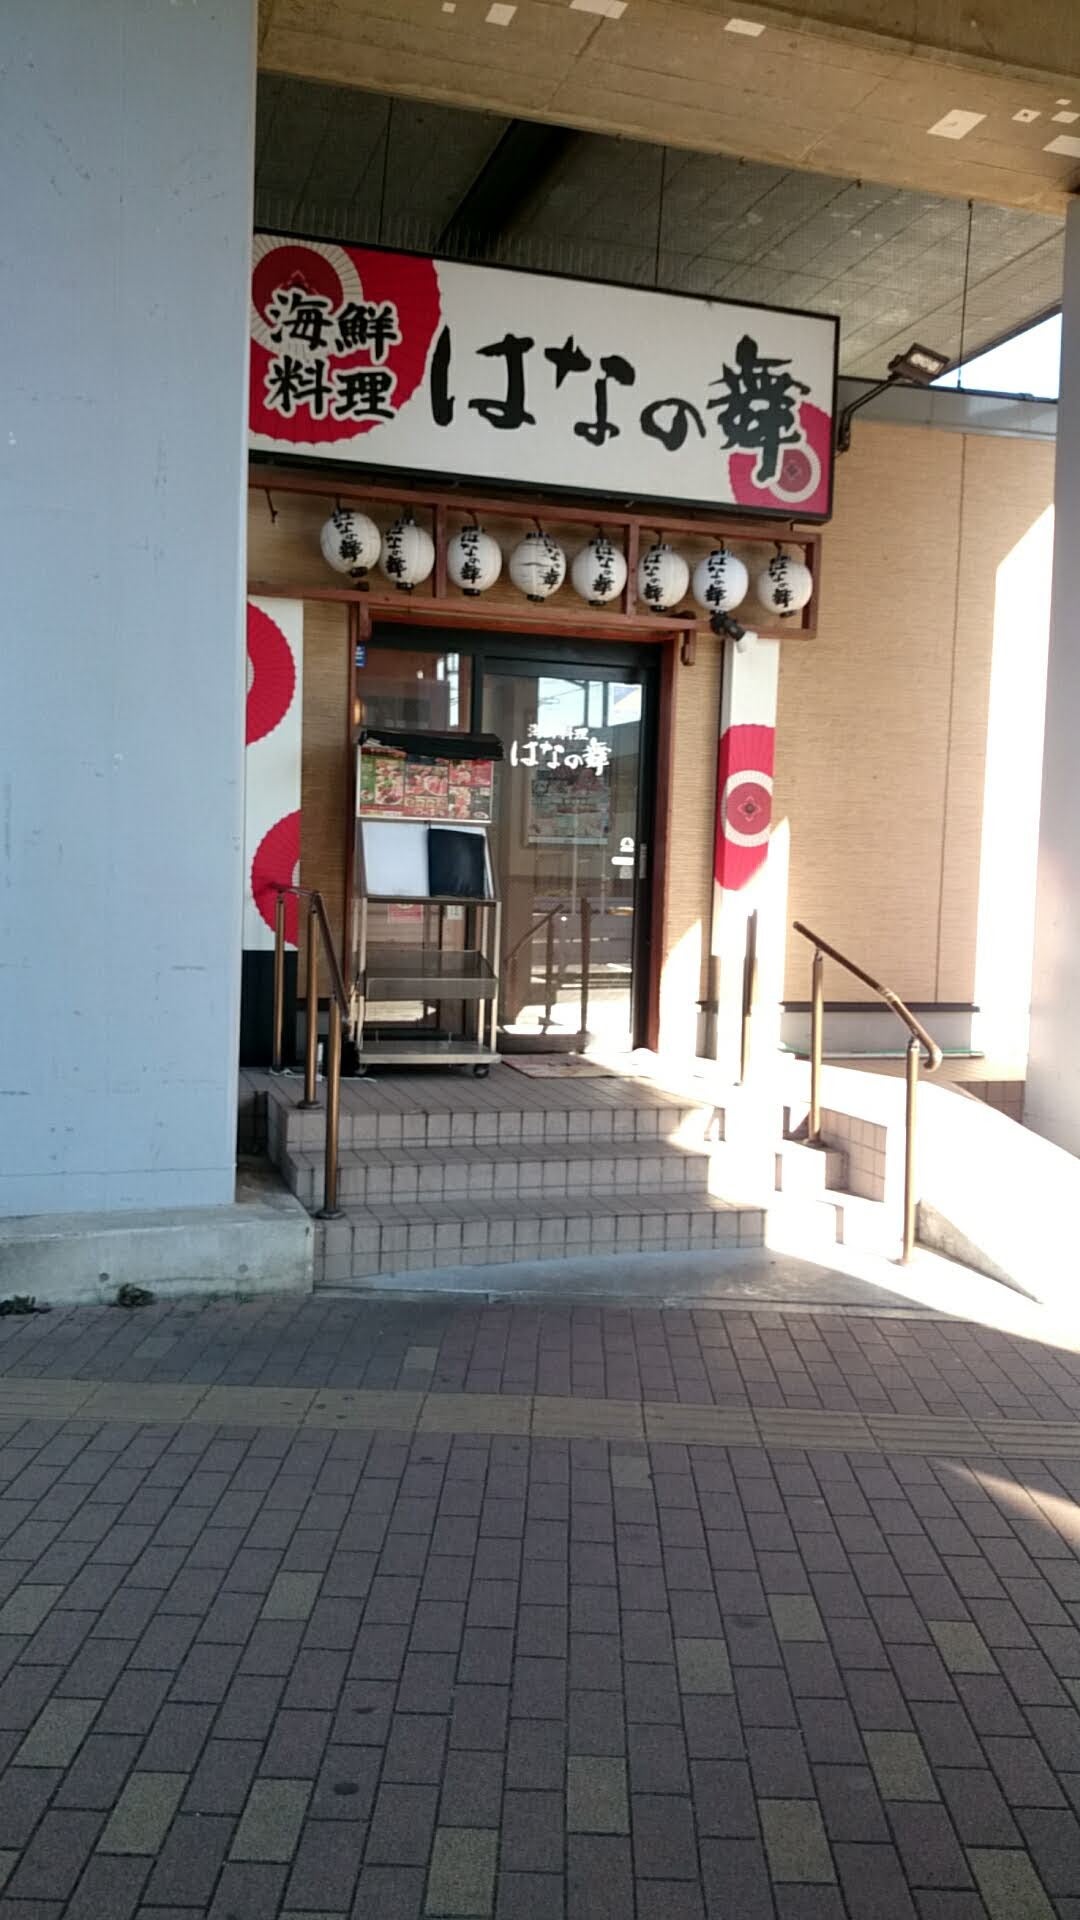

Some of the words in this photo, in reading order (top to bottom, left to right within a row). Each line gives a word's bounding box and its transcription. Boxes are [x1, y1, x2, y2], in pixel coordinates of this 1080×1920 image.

[270, 292, 397, 361] 海鮮
[268, 354, 396, 419] 料理
[431, 324, 811, 482] はなの舞
[460, 532, 482, 584] はなの舞
[644, 552, 664, 602] はなの舞
[705, 556, 728, 606] はなの舞
[510, 737, 612, 776] はなの舞
